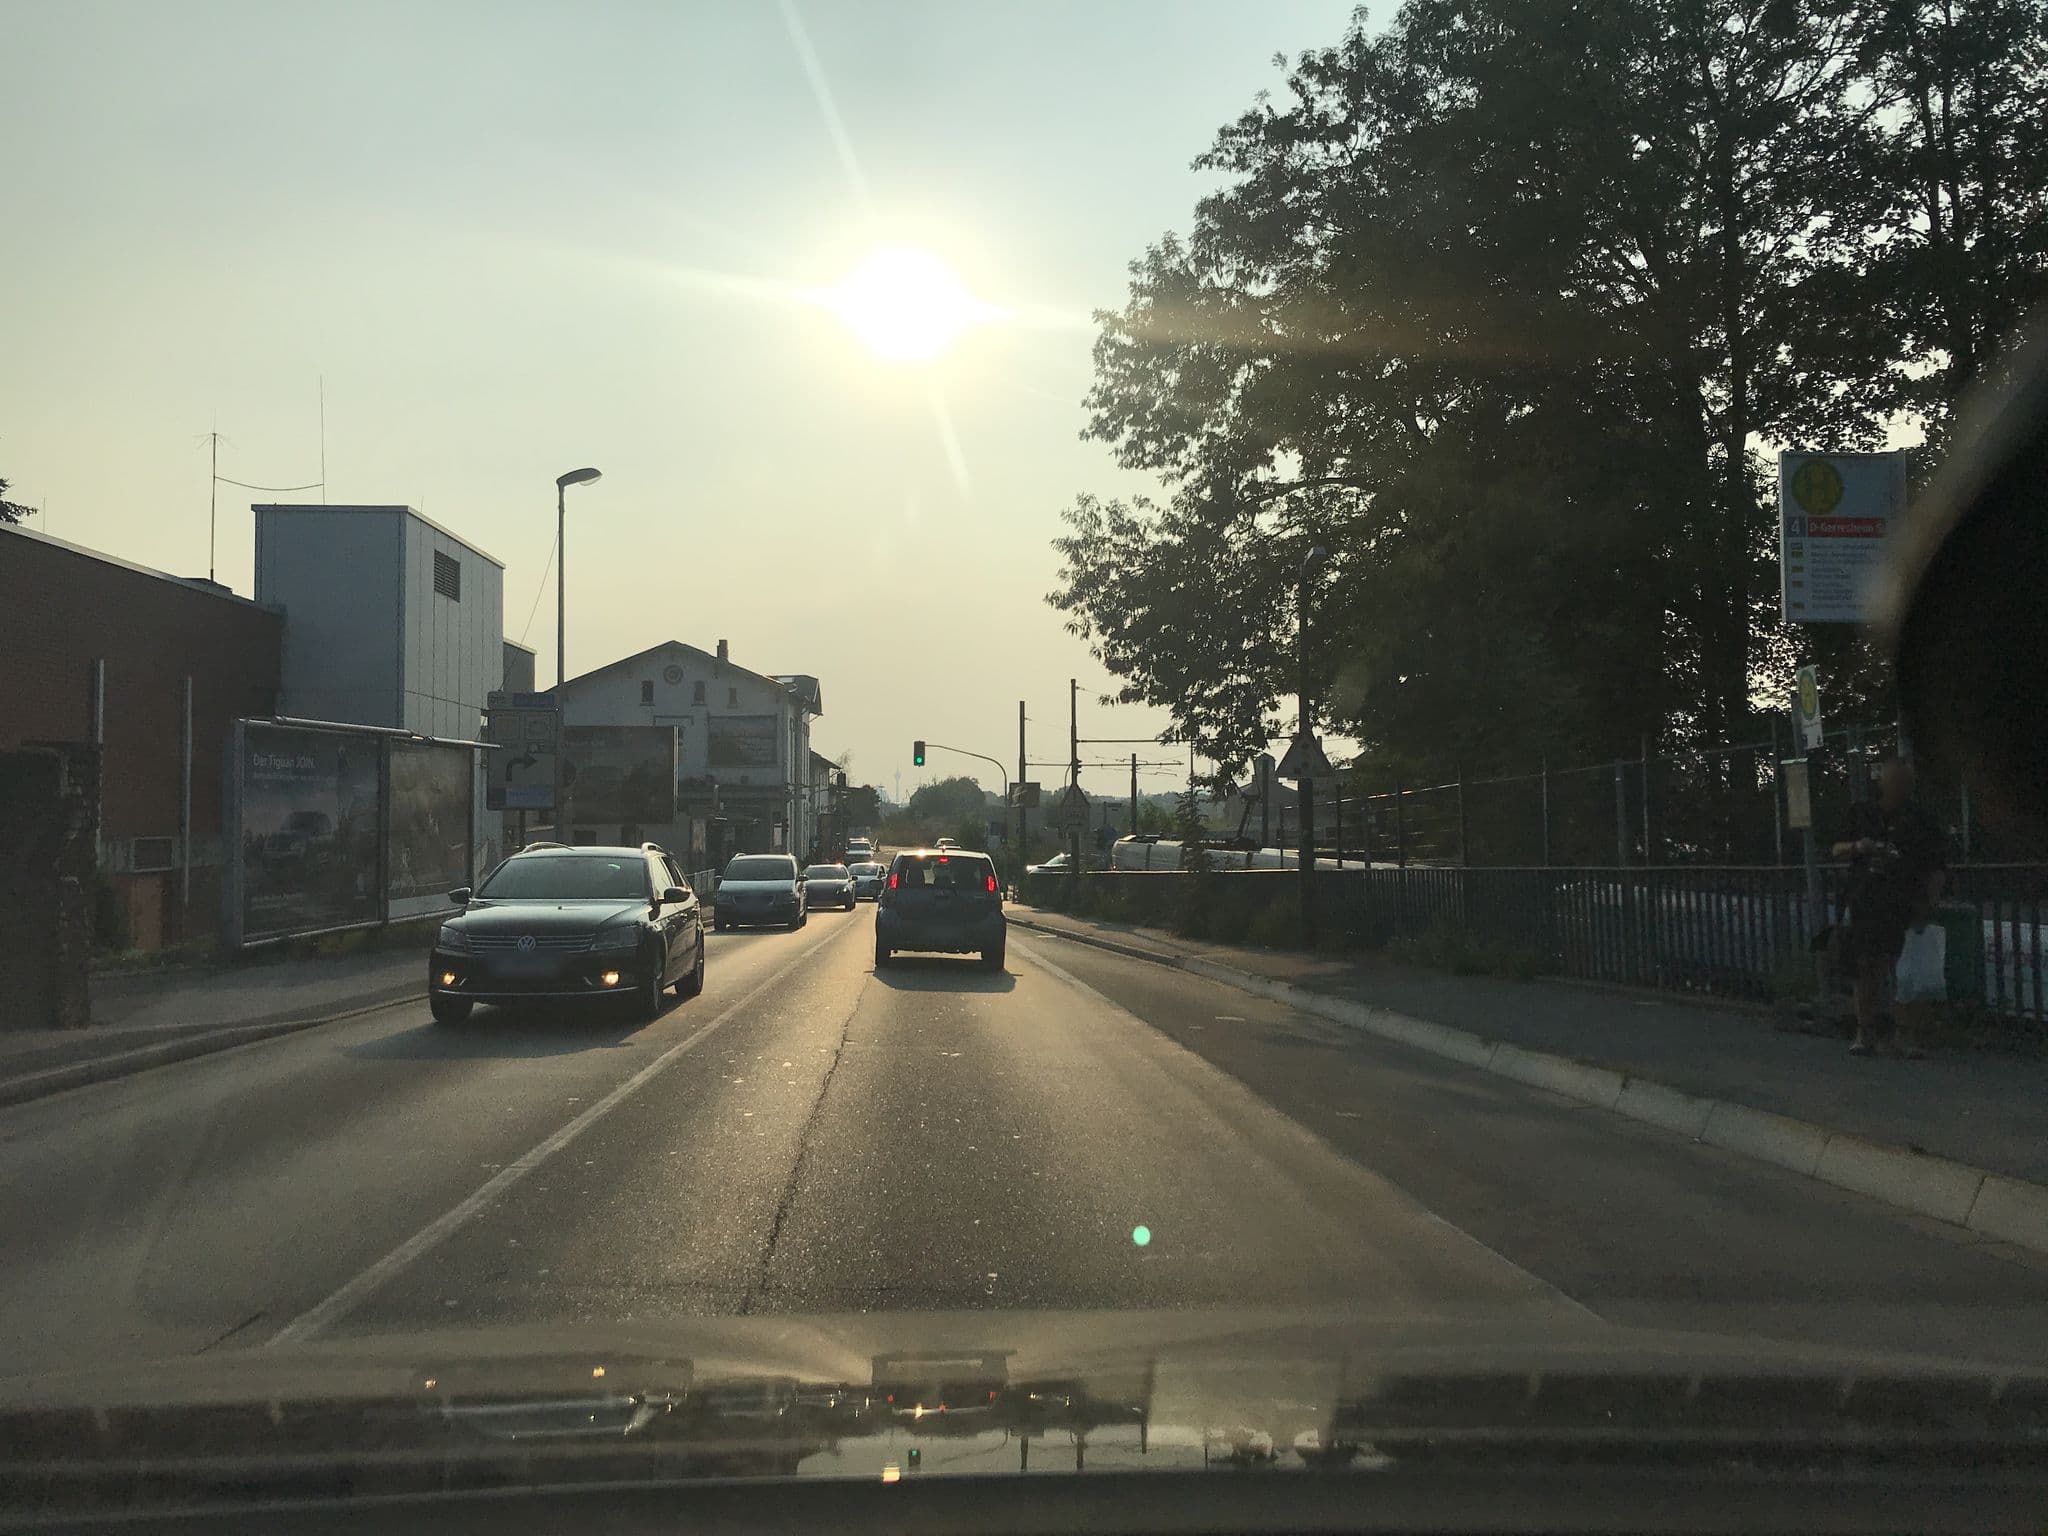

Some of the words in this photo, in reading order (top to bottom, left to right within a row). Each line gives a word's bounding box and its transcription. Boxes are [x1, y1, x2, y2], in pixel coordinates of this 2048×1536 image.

[1791, 519, 1801, 534] 4
[253, 753, 267, 767] Der
[268, 754, 295, 769] Tiguan
